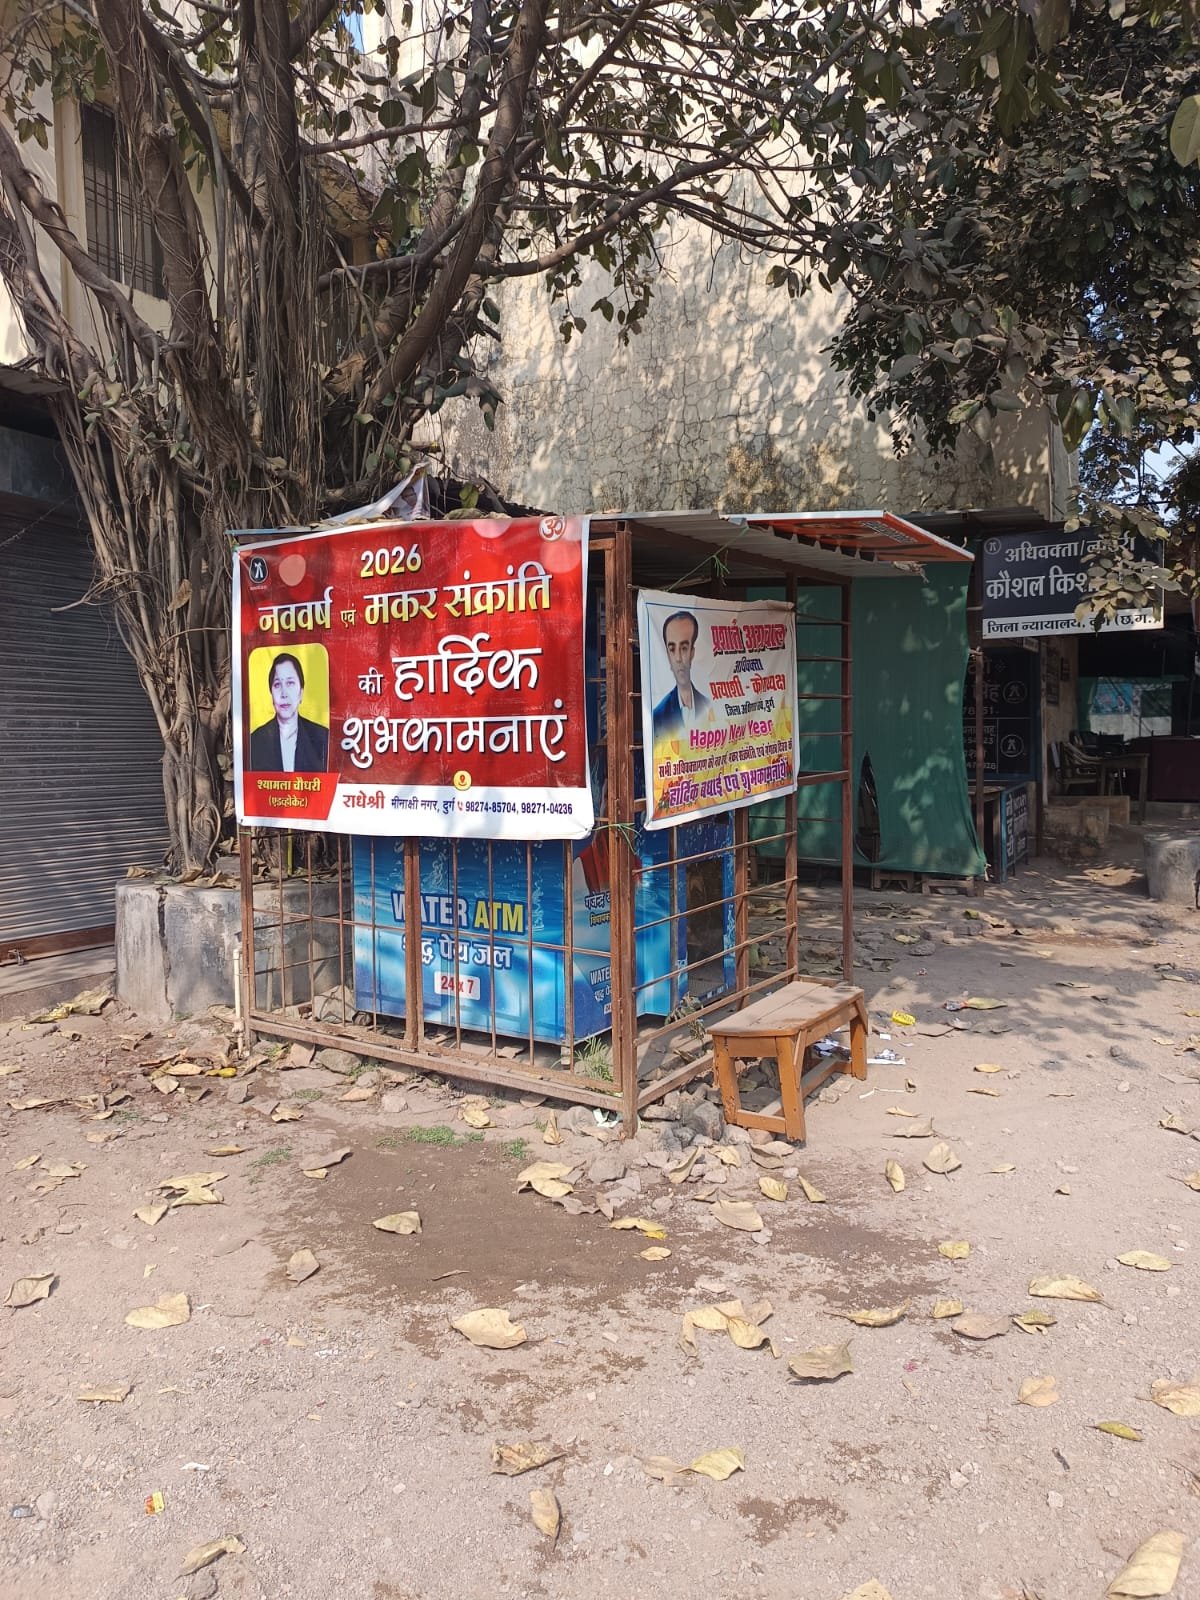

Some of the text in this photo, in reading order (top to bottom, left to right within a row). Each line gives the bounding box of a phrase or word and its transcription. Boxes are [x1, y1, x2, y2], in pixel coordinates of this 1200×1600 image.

[359, 543, 423, 578] 2026
[258, 560, 552, 634] नववर्ष एवं मकर संक्रांति
[986, 570, 1046, 600] कौशल
[987, 621, 1019, 634] जिला
[358, 632, 543, 701] की हार्दिक
[709, 675, 746, 701] प्रत्याशी
[340, 698, 568, 770] शुभकामनाएं
[690, 719, 773, 750] Happy New Year
[257, 776, 322, 792] श्यामला चौधरी
[669, 779, 699, 807] हार्दिक
[342, 790, 573, 816] राधेश्री मीनाक्षी नगर, दुर्ग 98274-85704, 98271-04236
[474, 899, 524, 933] ATM
[472, 943, 513, 969] जल
[441, 975, 455, 992] 24
[467, 979, 475, 994] 7
[590, 966, 612, 986] WATE
